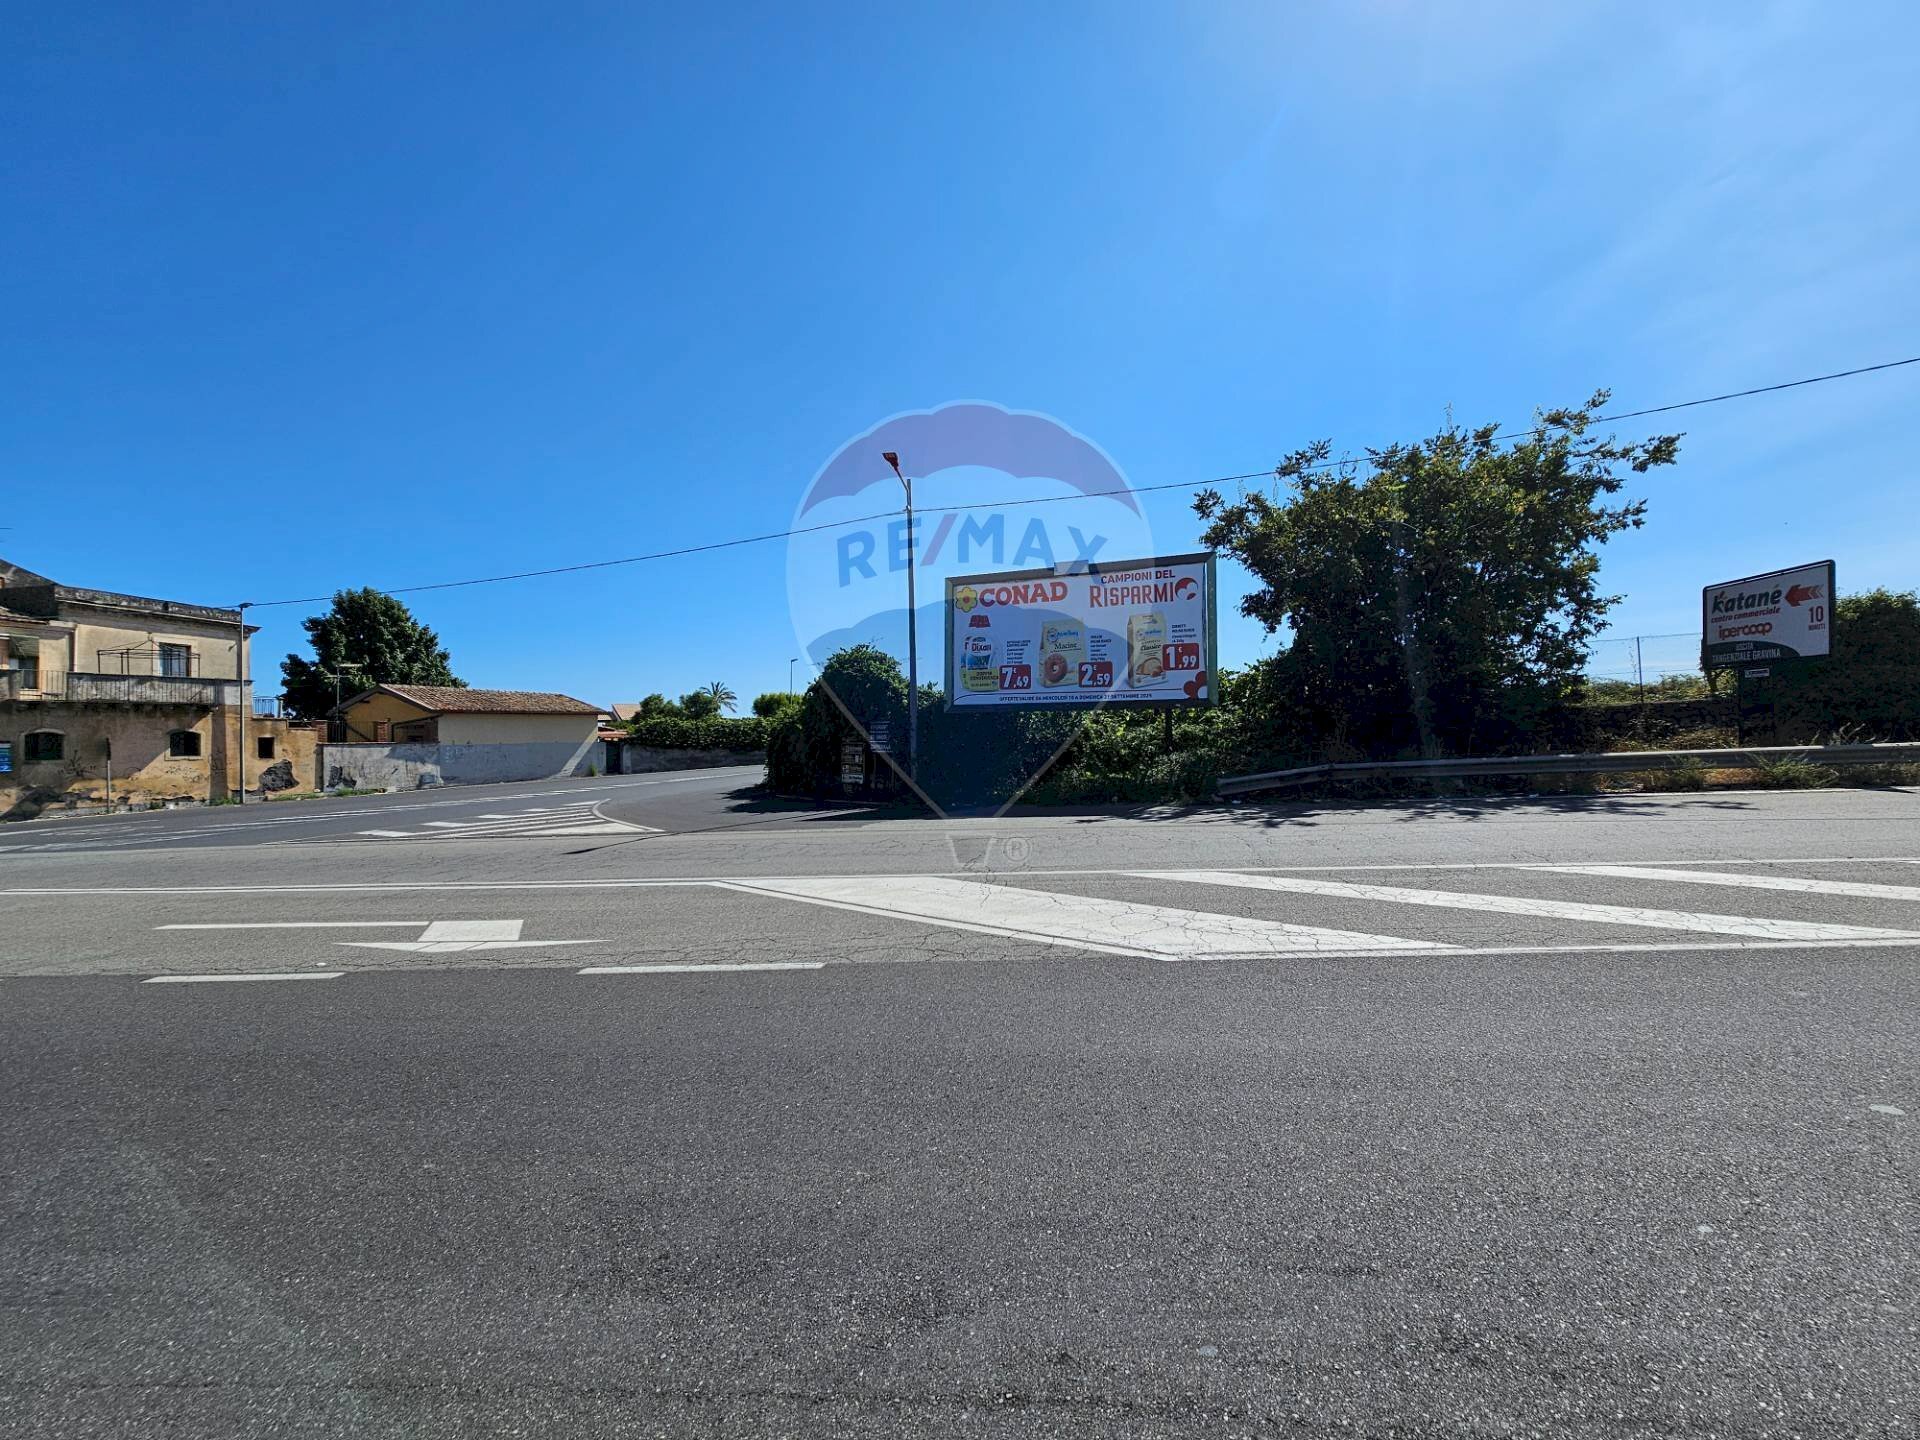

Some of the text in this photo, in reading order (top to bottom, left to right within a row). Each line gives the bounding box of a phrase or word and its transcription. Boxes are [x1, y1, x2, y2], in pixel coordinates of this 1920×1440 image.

[1100, 569, 1176, 585] CAMPIONI DEL
[978, 581, 1068, 608] CONAD
[1733, 606, 1781, 620] commerciale
[1808, 605, 1824, 623] 10
[1718, 621, 1773, 640] ipercoop
